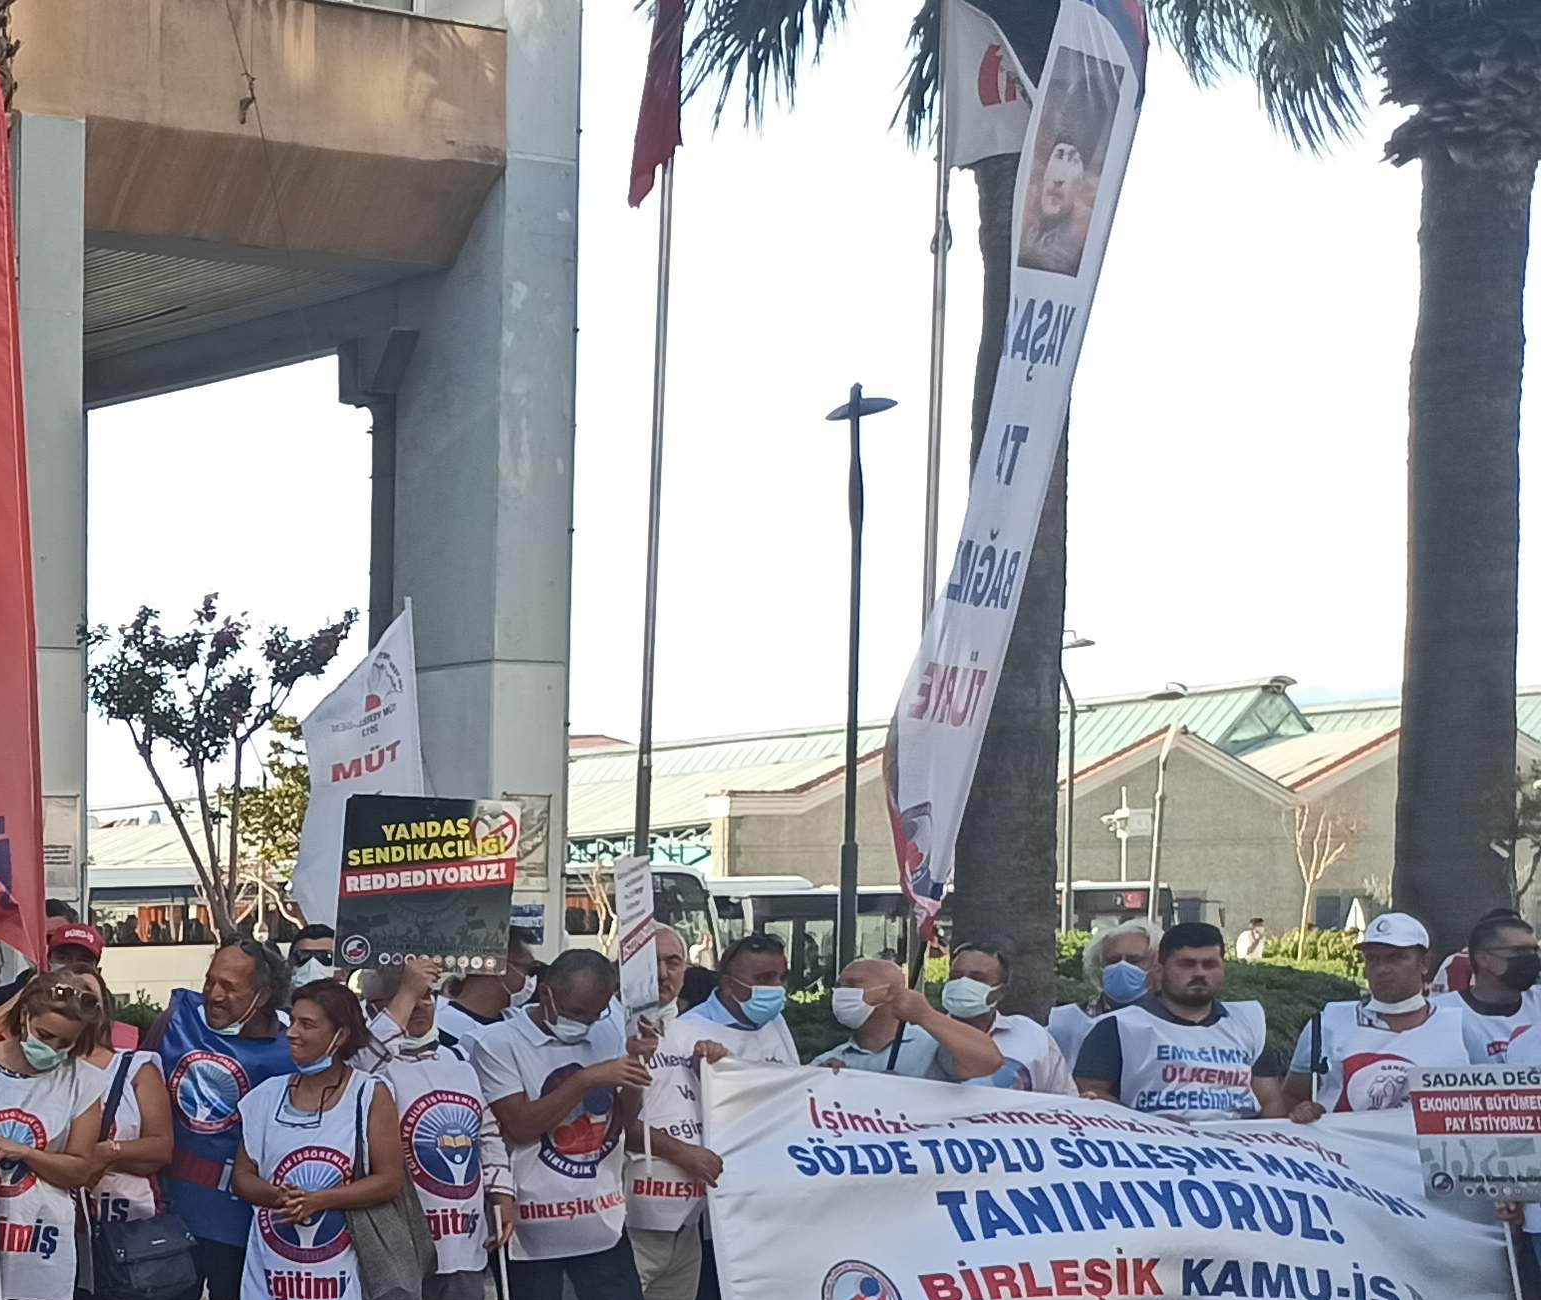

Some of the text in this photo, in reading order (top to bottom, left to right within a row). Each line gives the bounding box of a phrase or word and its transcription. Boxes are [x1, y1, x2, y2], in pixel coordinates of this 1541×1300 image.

[381, 818, 470, 841] YANDAŞ
[1421, 1071, 1497, 1087] SADAKA
[1419, 1094, 1482, 1112] EKONOMİK
[1444, 1117, 1466, 1132] PAY
[1470, 1114, 1535, 1132] İSTİYORUZ
[787, 1136, 919, 1177] SÖZDE
[918, 1137, 1046, 1175] TOPLU
[1050, 1130, 1255, 1176] SÖZLEŞME
[519, 1197, 597, 1221] BİRLEŞİK
[935, 1178, 1346, 1245] TANIMIYORUZ!
